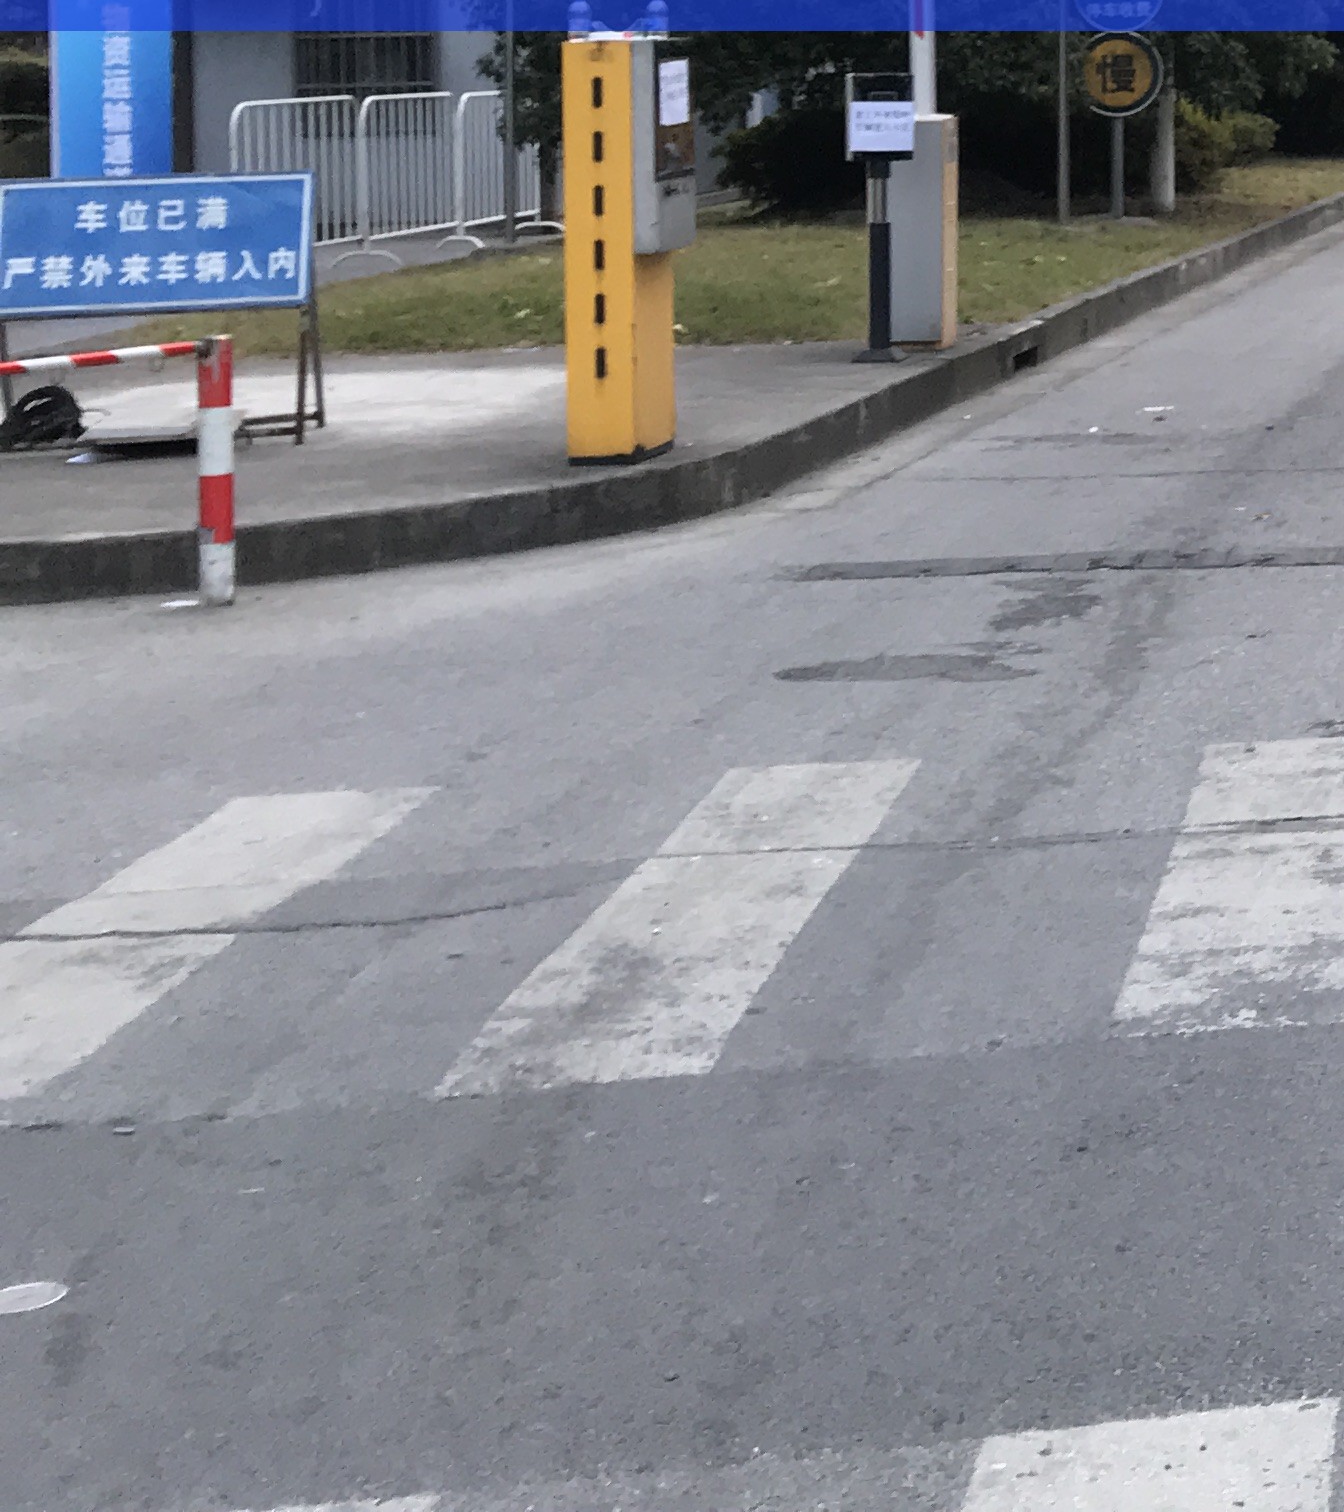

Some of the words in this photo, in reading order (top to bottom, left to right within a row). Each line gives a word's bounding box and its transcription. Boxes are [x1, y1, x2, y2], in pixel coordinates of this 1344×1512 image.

[1096, 54, 1136, 94] 慢
[74, 196, 229, 233] 车位已满
[3, 247, 297, 289] 严禁外来车辆入内
